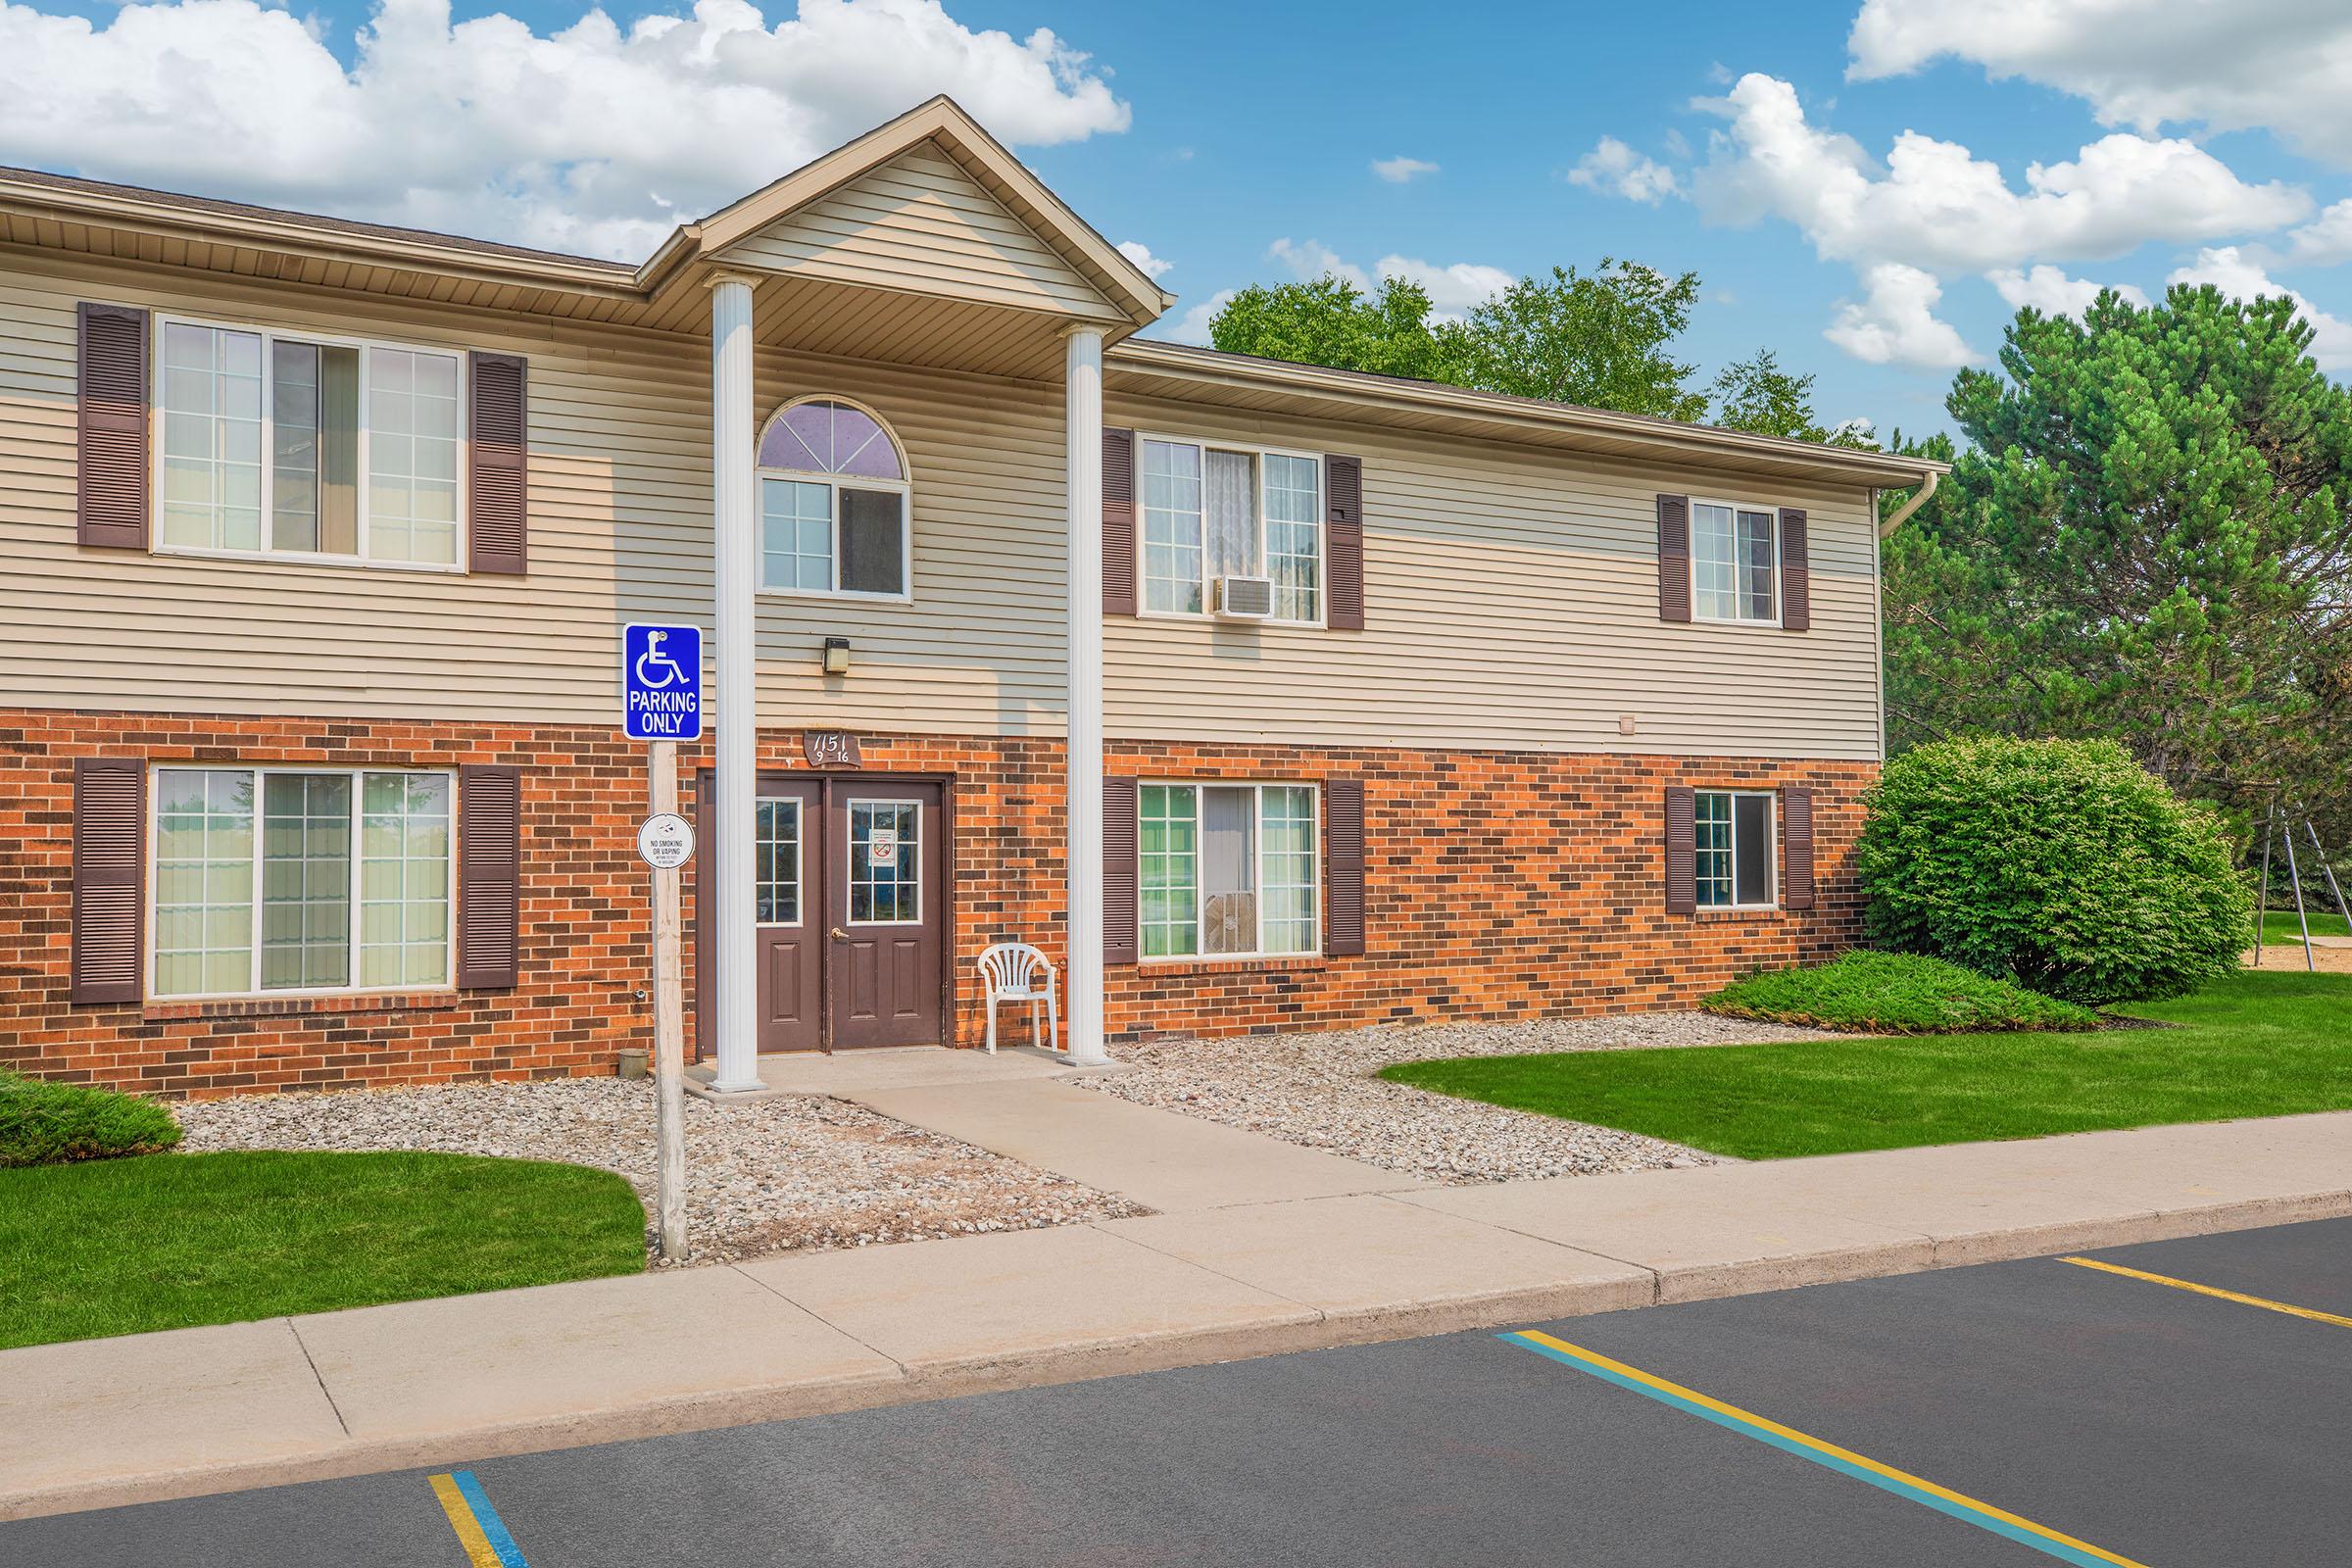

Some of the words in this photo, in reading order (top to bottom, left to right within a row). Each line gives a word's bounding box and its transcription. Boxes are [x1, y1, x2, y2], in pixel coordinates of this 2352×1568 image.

[630, 690, 696, 712] PARKING
[642, 712, 684, 733] ONLY
[813, 735, 846, 752] 1151
[816, 751, 823, 761] 9
[837, 751, 849, 761] 16
